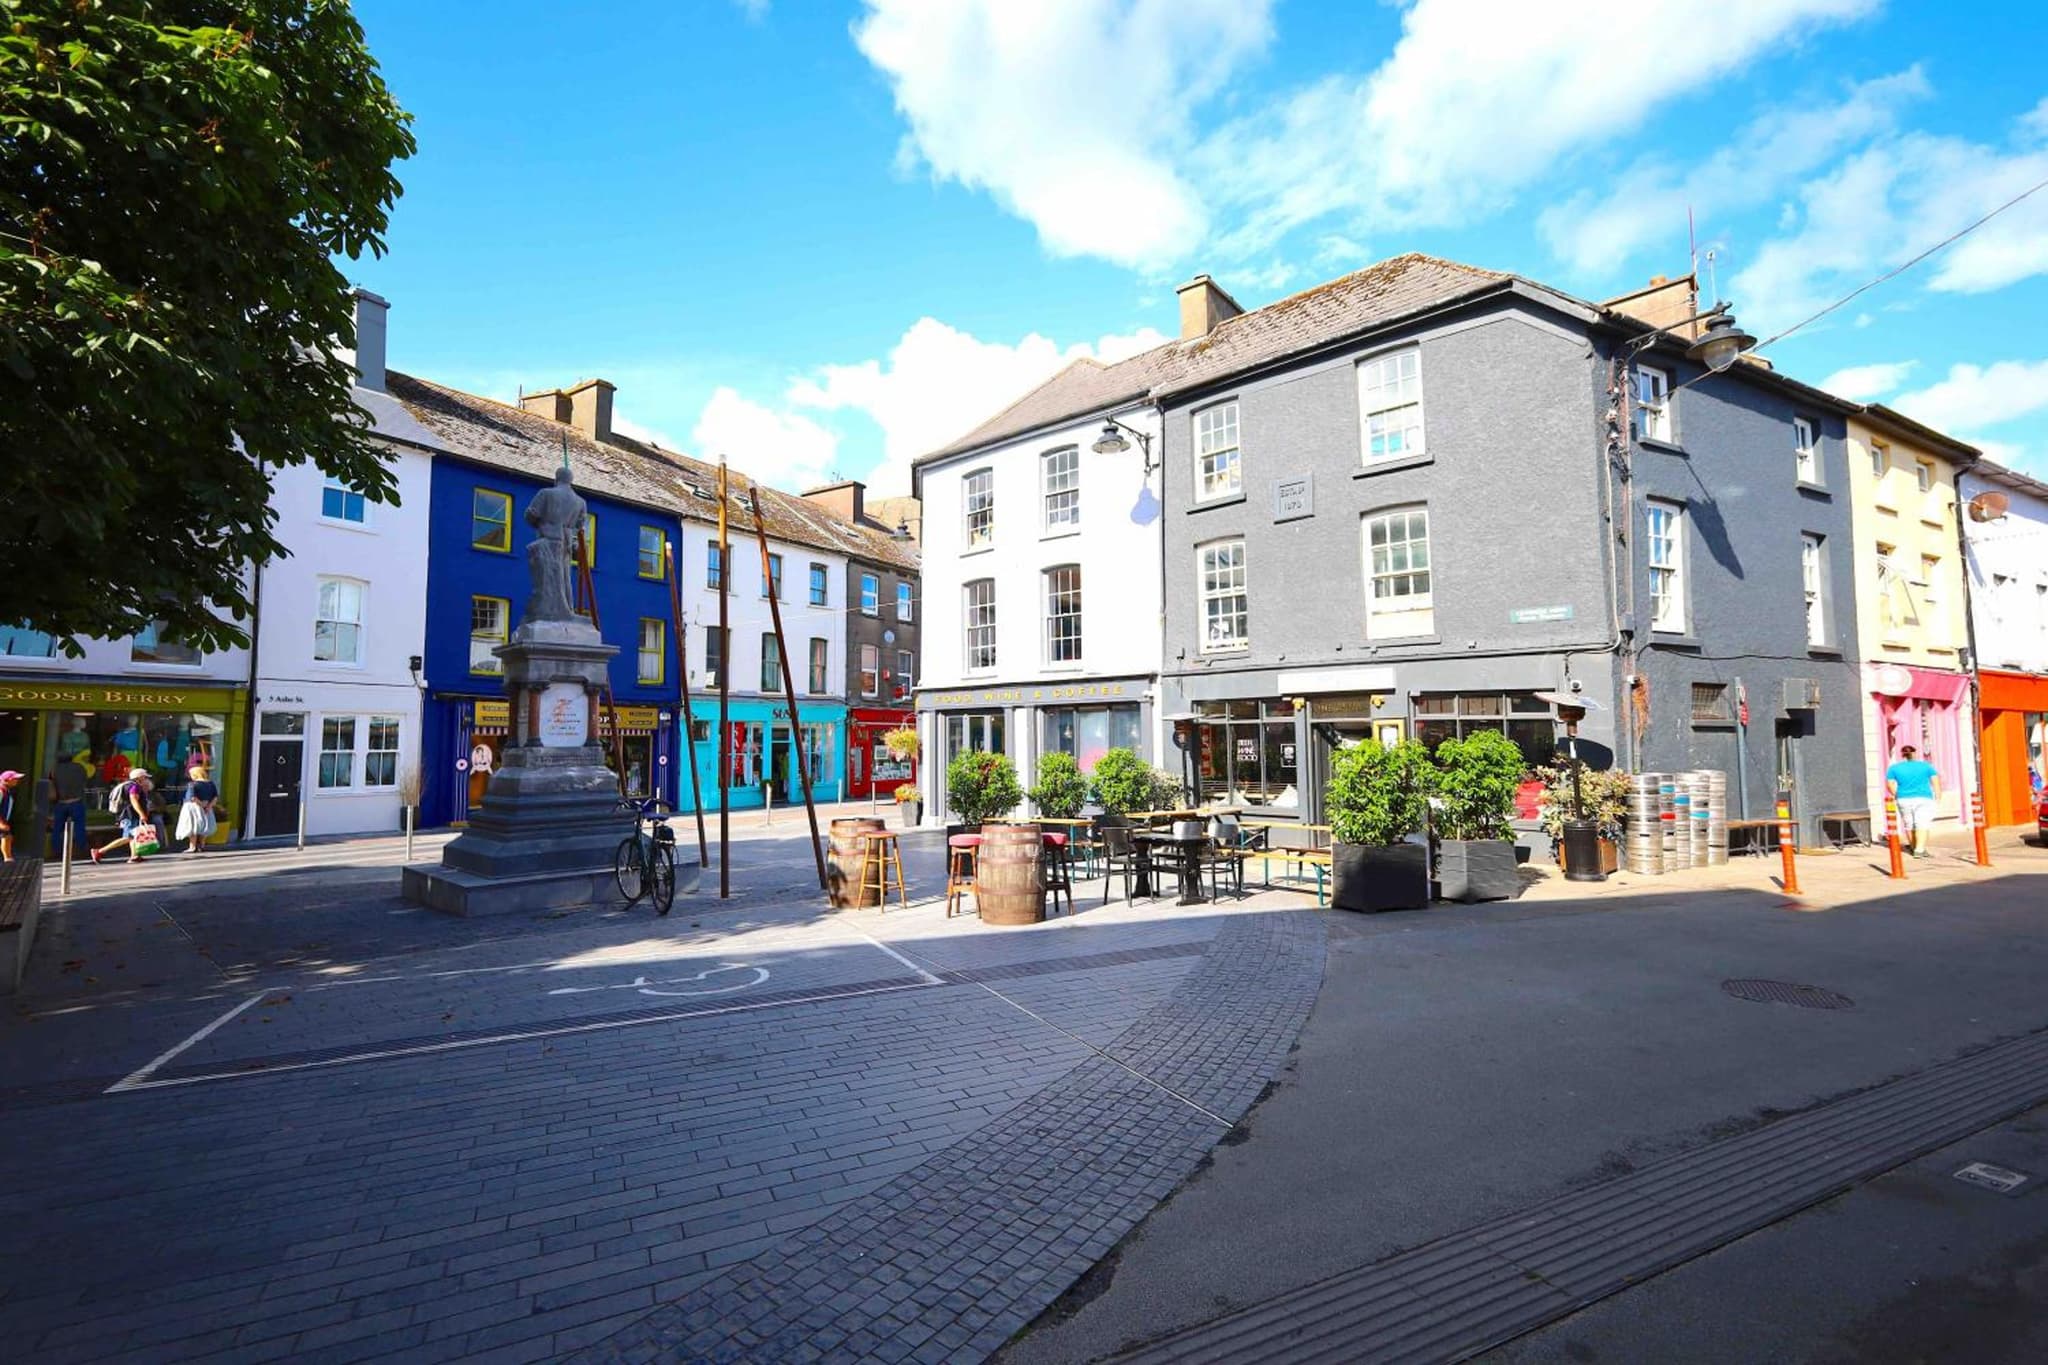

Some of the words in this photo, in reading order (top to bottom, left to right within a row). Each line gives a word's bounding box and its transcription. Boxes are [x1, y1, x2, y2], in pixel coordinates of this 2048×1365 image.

[0, 687, 92, 702] GOOSE
[105, 690, 187, 704] BERRY
[933, 692, 974, 703] FOOD
[984, 687, 1021, 701] WINE
[1053, 684, 1124, 698] COFFEE
